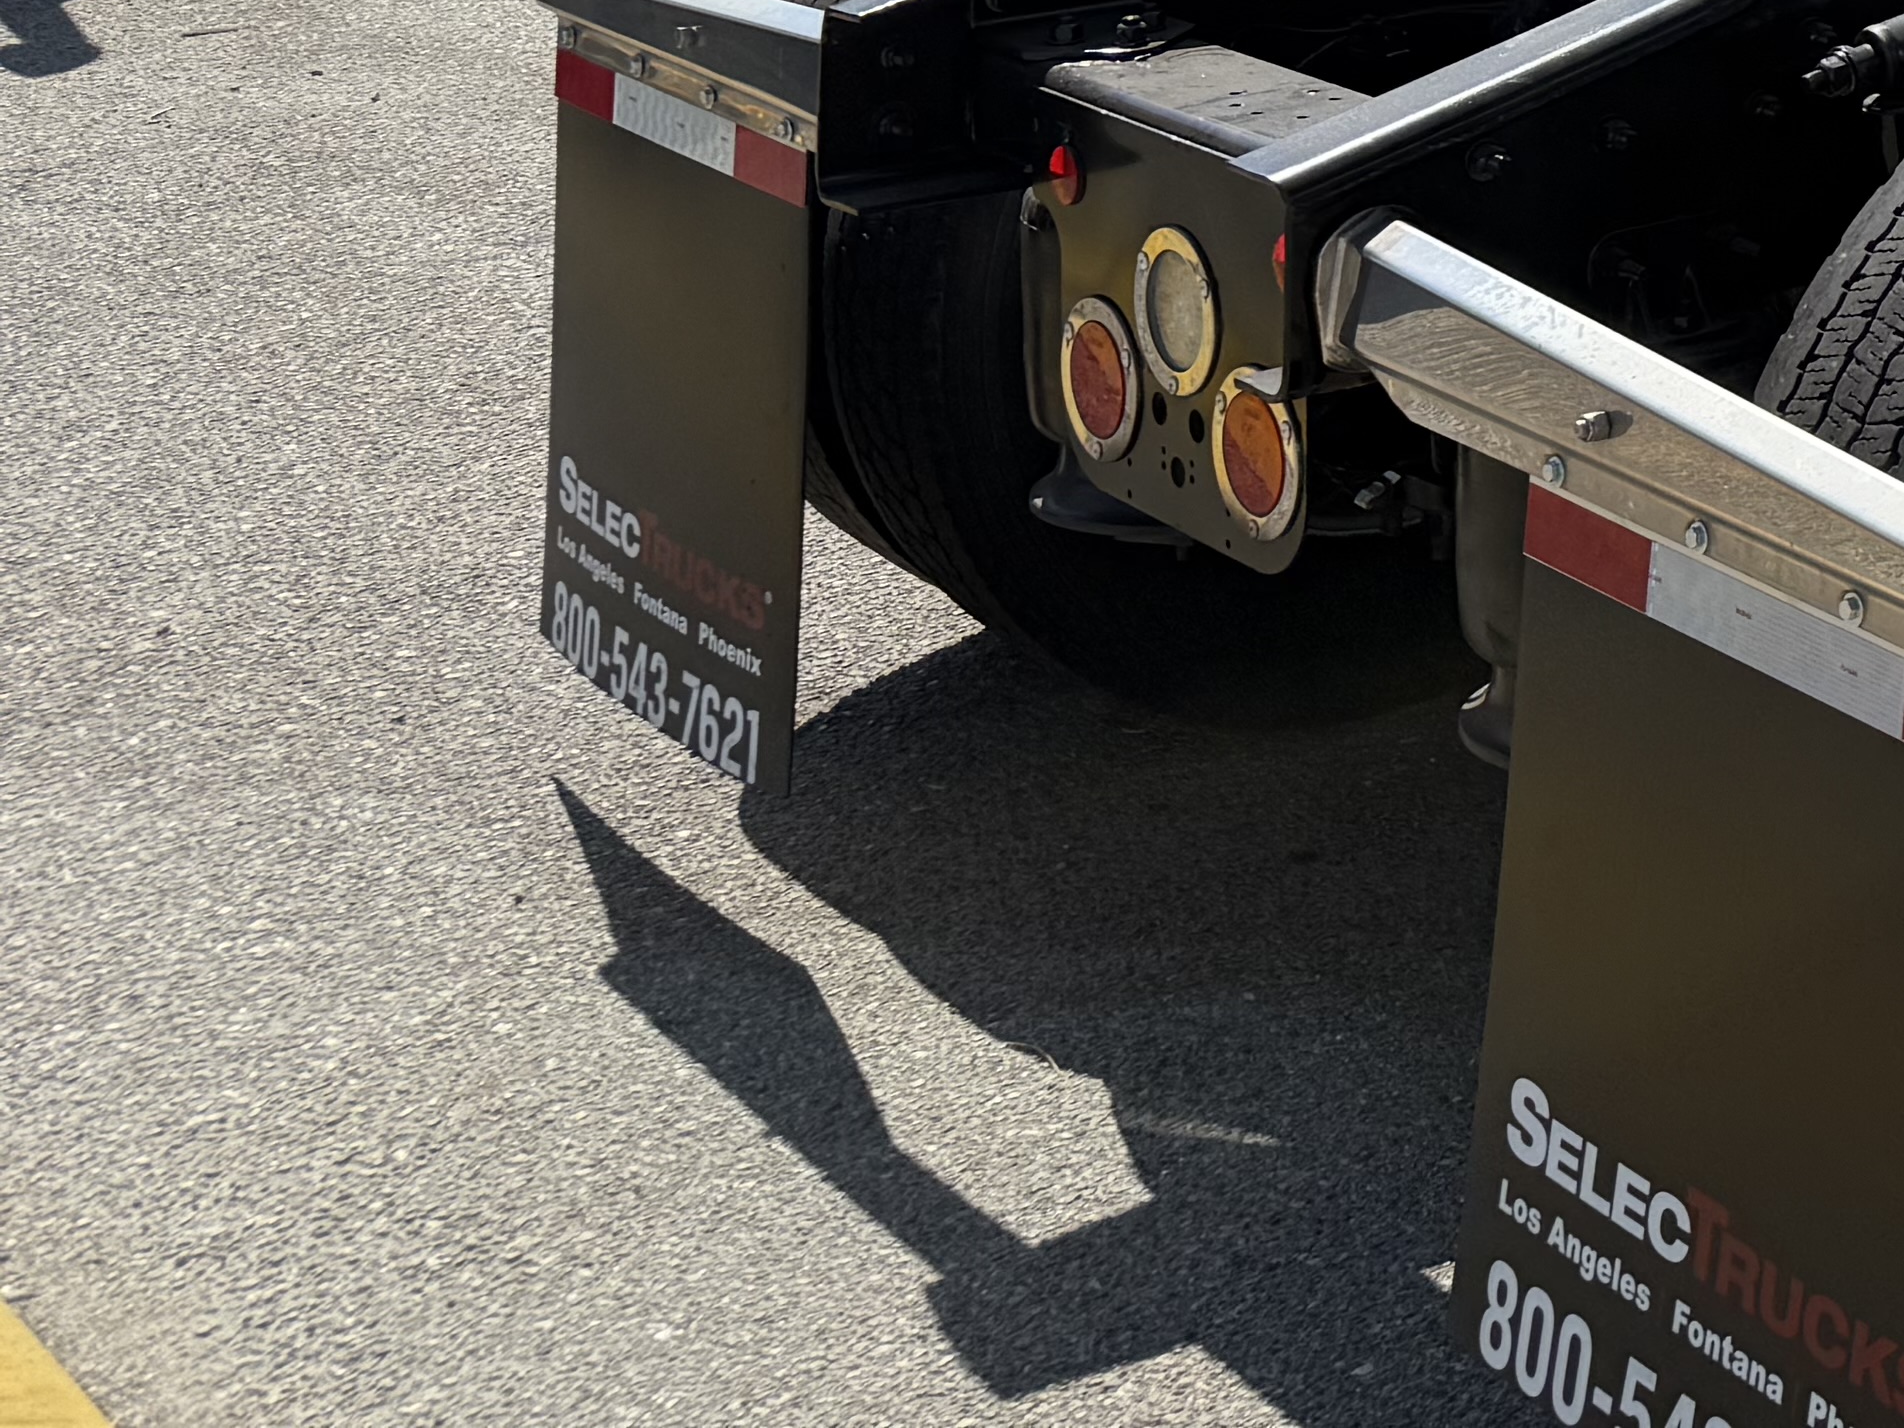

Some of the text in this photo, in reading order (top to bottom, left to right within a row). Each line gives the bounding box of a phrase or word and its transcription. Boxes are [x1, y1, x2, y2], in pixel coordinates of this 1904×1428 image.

[552, 580, 760, 784] 800-543-7621
[557, 525, 762, 676] Los Angeles Fontana Phoenix
[1479, 1260, 1735, 1428] 800-5
[1499, 1178, 1854, 1428] Los Angeles Fontana Ph
